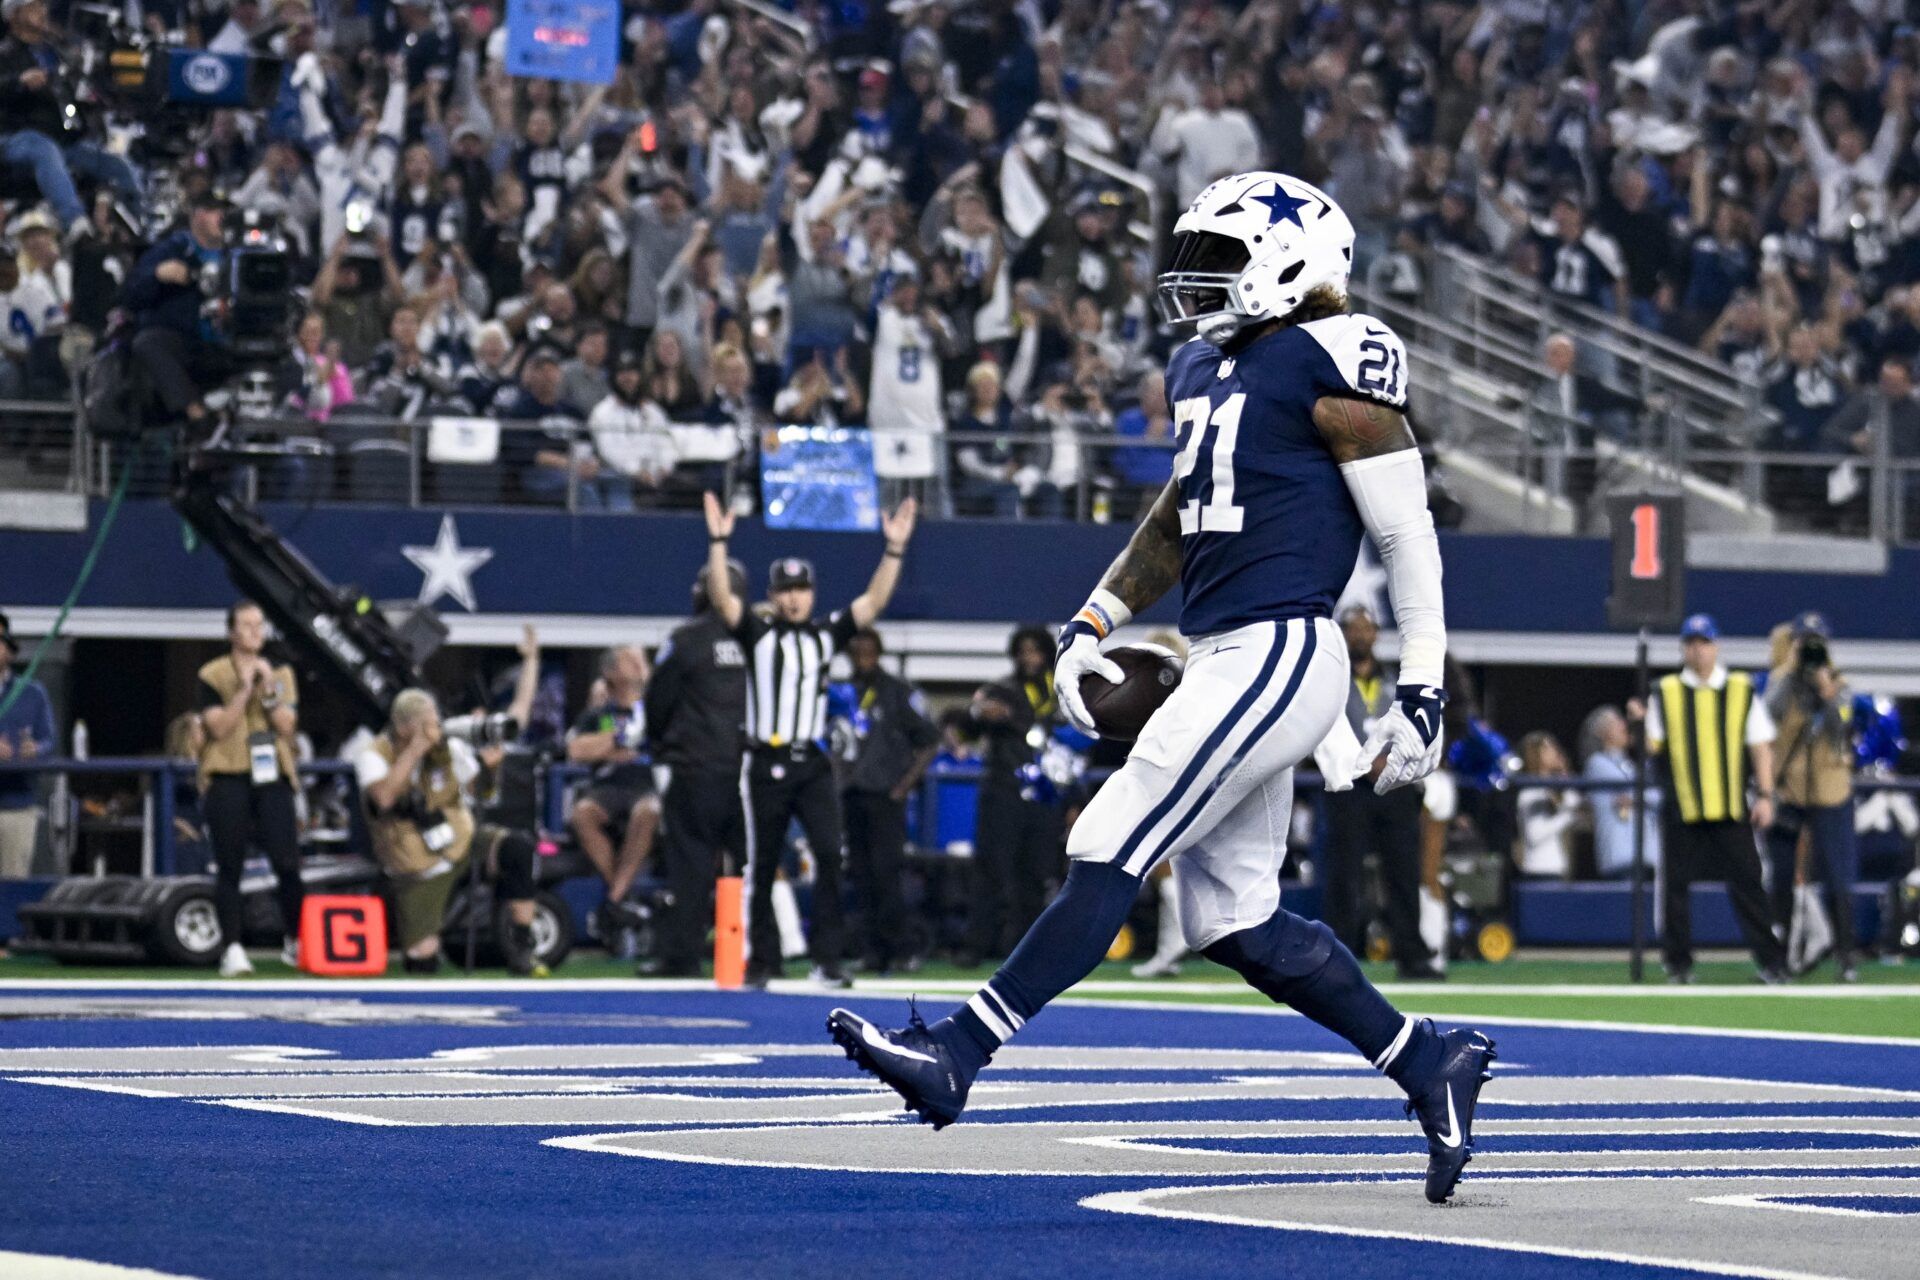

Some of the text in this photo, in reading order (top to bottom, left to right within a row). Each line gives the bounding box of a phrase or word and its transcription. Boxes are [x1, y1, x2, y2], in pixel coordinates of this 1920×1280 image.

[1358, 339, 1401, 397] 21
[1172, 393, 1246, 536] 21
[1630, 504, 1660, 579] 1
[322, 907, 368, 963] G
